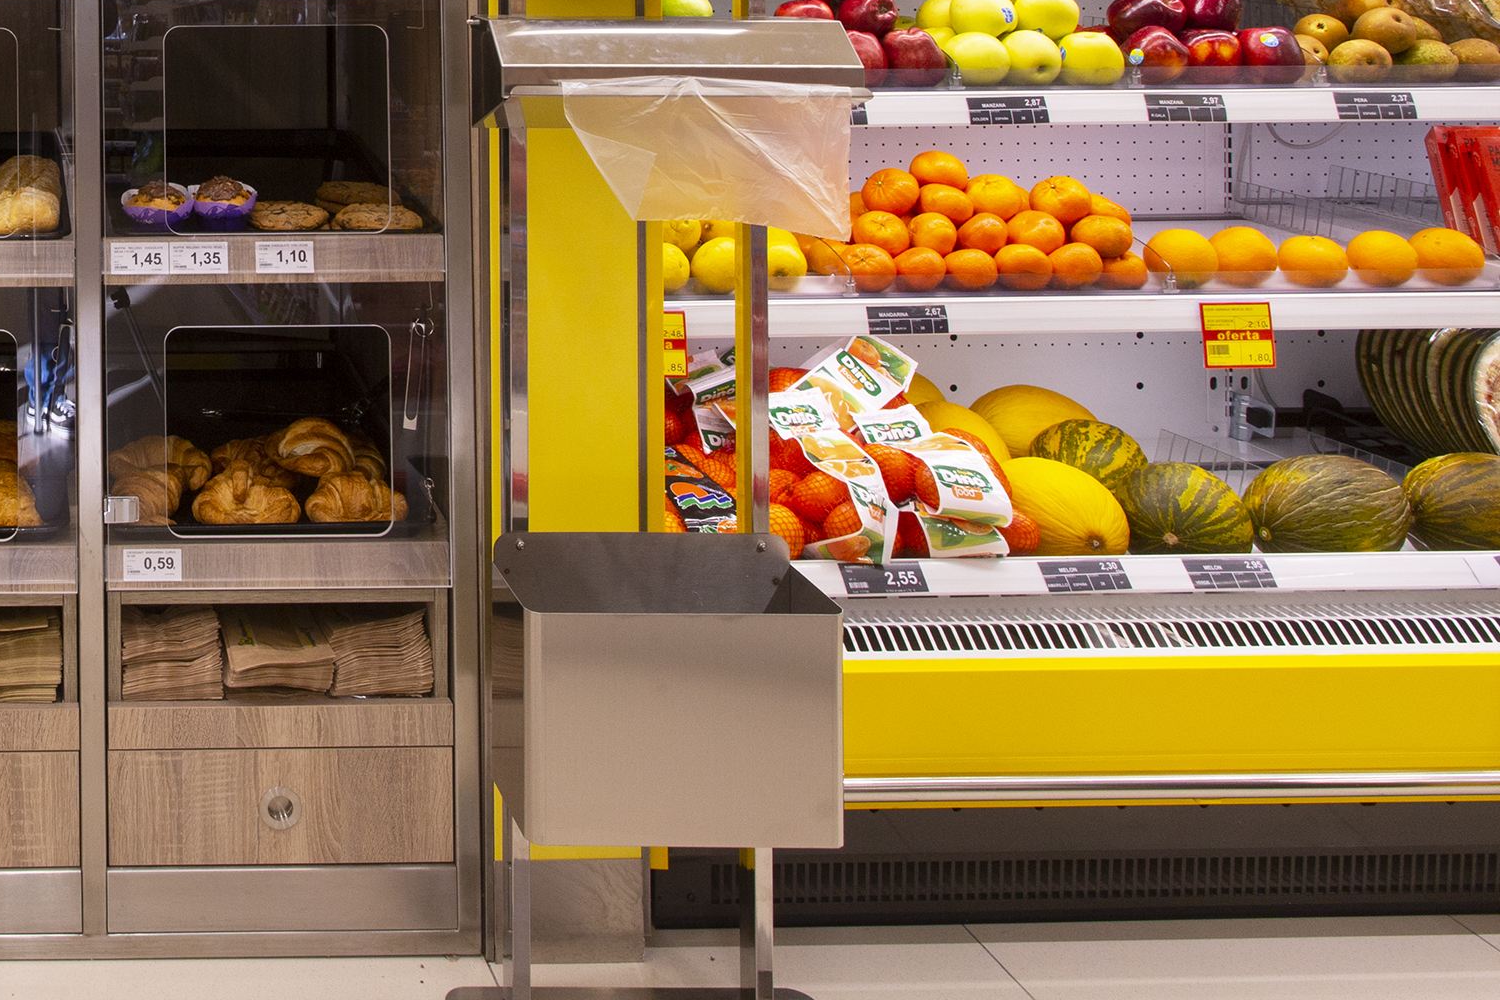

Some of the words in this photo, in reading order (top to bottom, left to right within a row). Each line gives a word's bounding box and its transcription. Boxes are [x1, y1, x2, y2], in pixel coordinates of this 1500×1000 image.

[1024, 99, 1041, 107] 2,87
[1202, 97, 1218, 105] 2,97
[1391, 94, 1408, 102] 2,37
[925, 308, 941, 316] 2,67
[1217, 330, 1259, 341] oferta
[841, 355, 877, 393] Dino
[701, 388, 735, 403] Dino
[873, 425, 916, 441] Dino
[941, 468, 987, 488] Dino
[1099, 561, 1117, 572] 2,30
